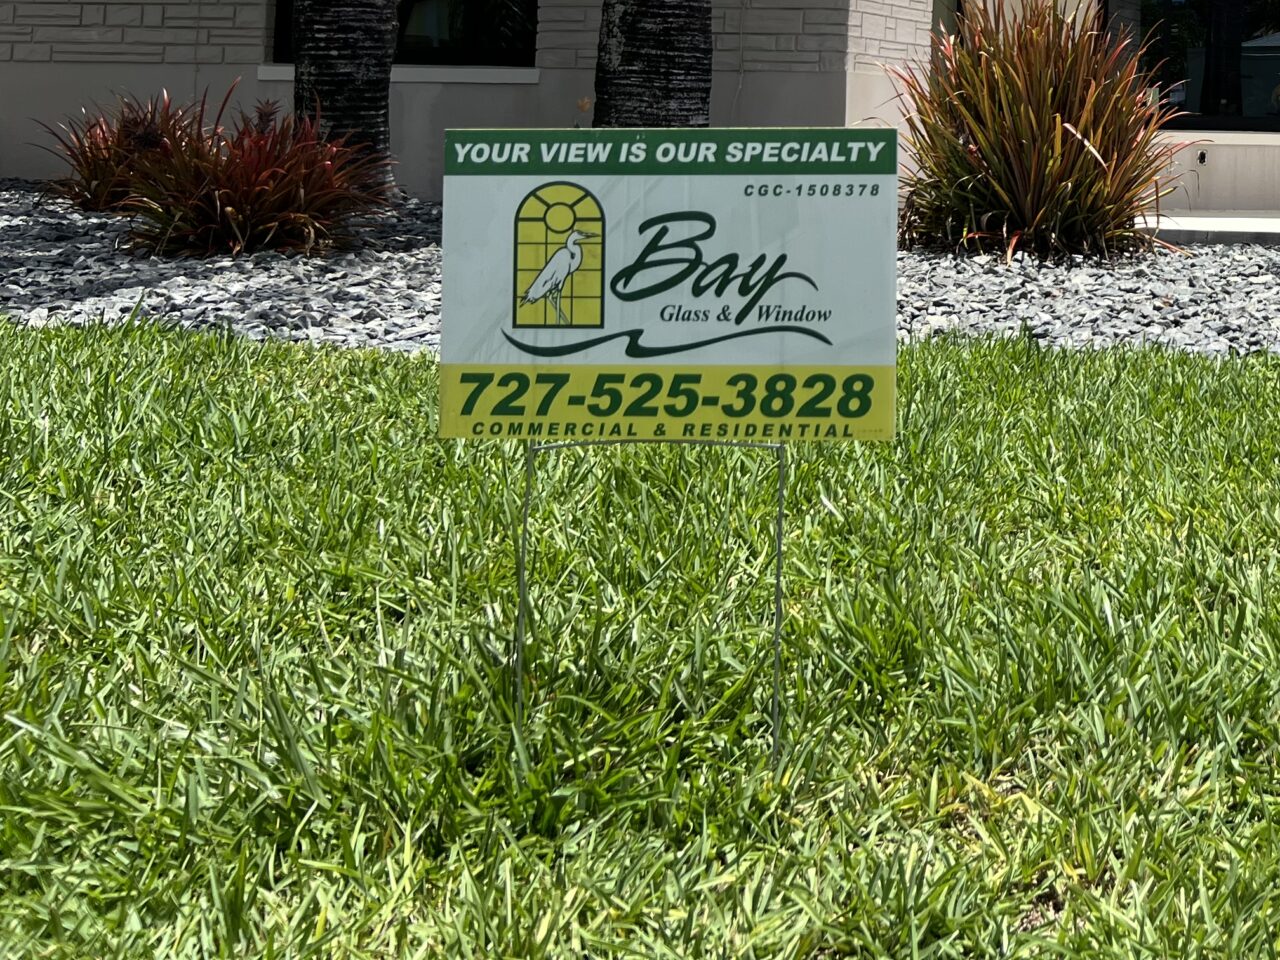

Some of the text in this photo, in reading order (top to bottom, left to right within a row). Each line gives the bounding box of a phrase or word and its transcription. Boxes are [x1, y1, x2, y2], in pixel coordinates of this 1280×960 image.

[454, 141, 886, 163] YOUR VIEW IS OUR SPECIALTY
[743, 184, 881, 197] CGC-1508378
[610, 211, 819, 325] Bay
[659, 304, 832, 323] Glass & Window
[459, 373, 875, 418] 727-525-3828
[472, 422, 854, 438] COMMERCIAL & RESIDENTIAL
